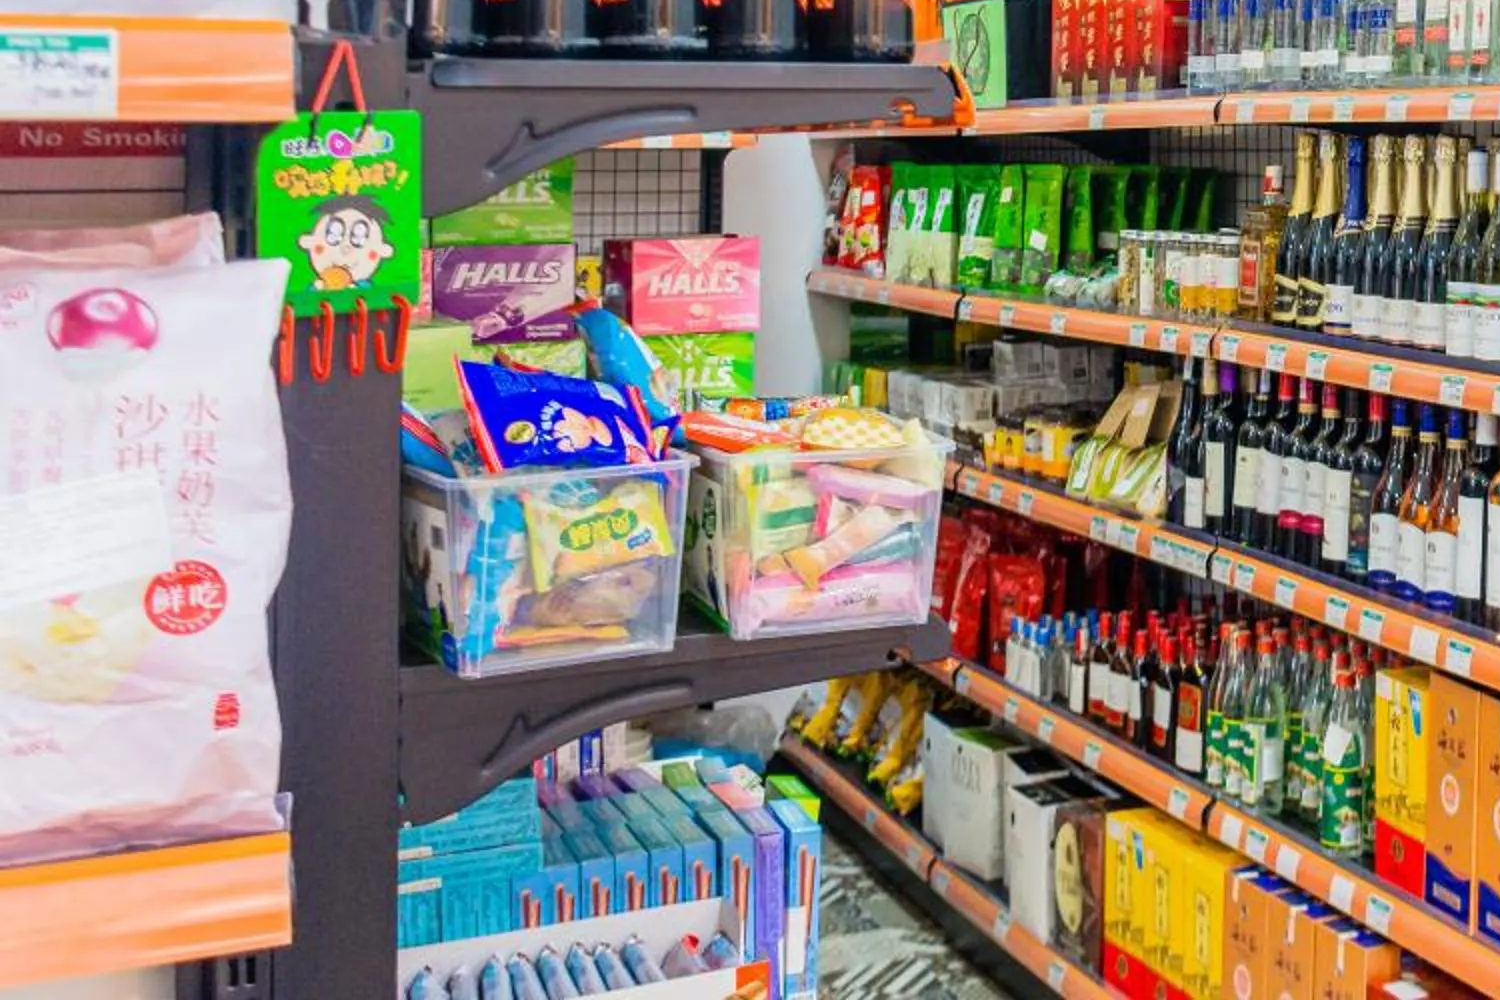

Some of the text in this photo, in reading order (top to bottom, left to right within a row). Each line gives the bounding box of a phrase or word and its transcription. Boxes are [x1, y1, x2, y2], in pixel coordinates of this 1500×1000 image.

[19, 126, 64, 148] No
[450, 260, 563, 293] HALLS
[647, 271, 745, 298] HALLS
